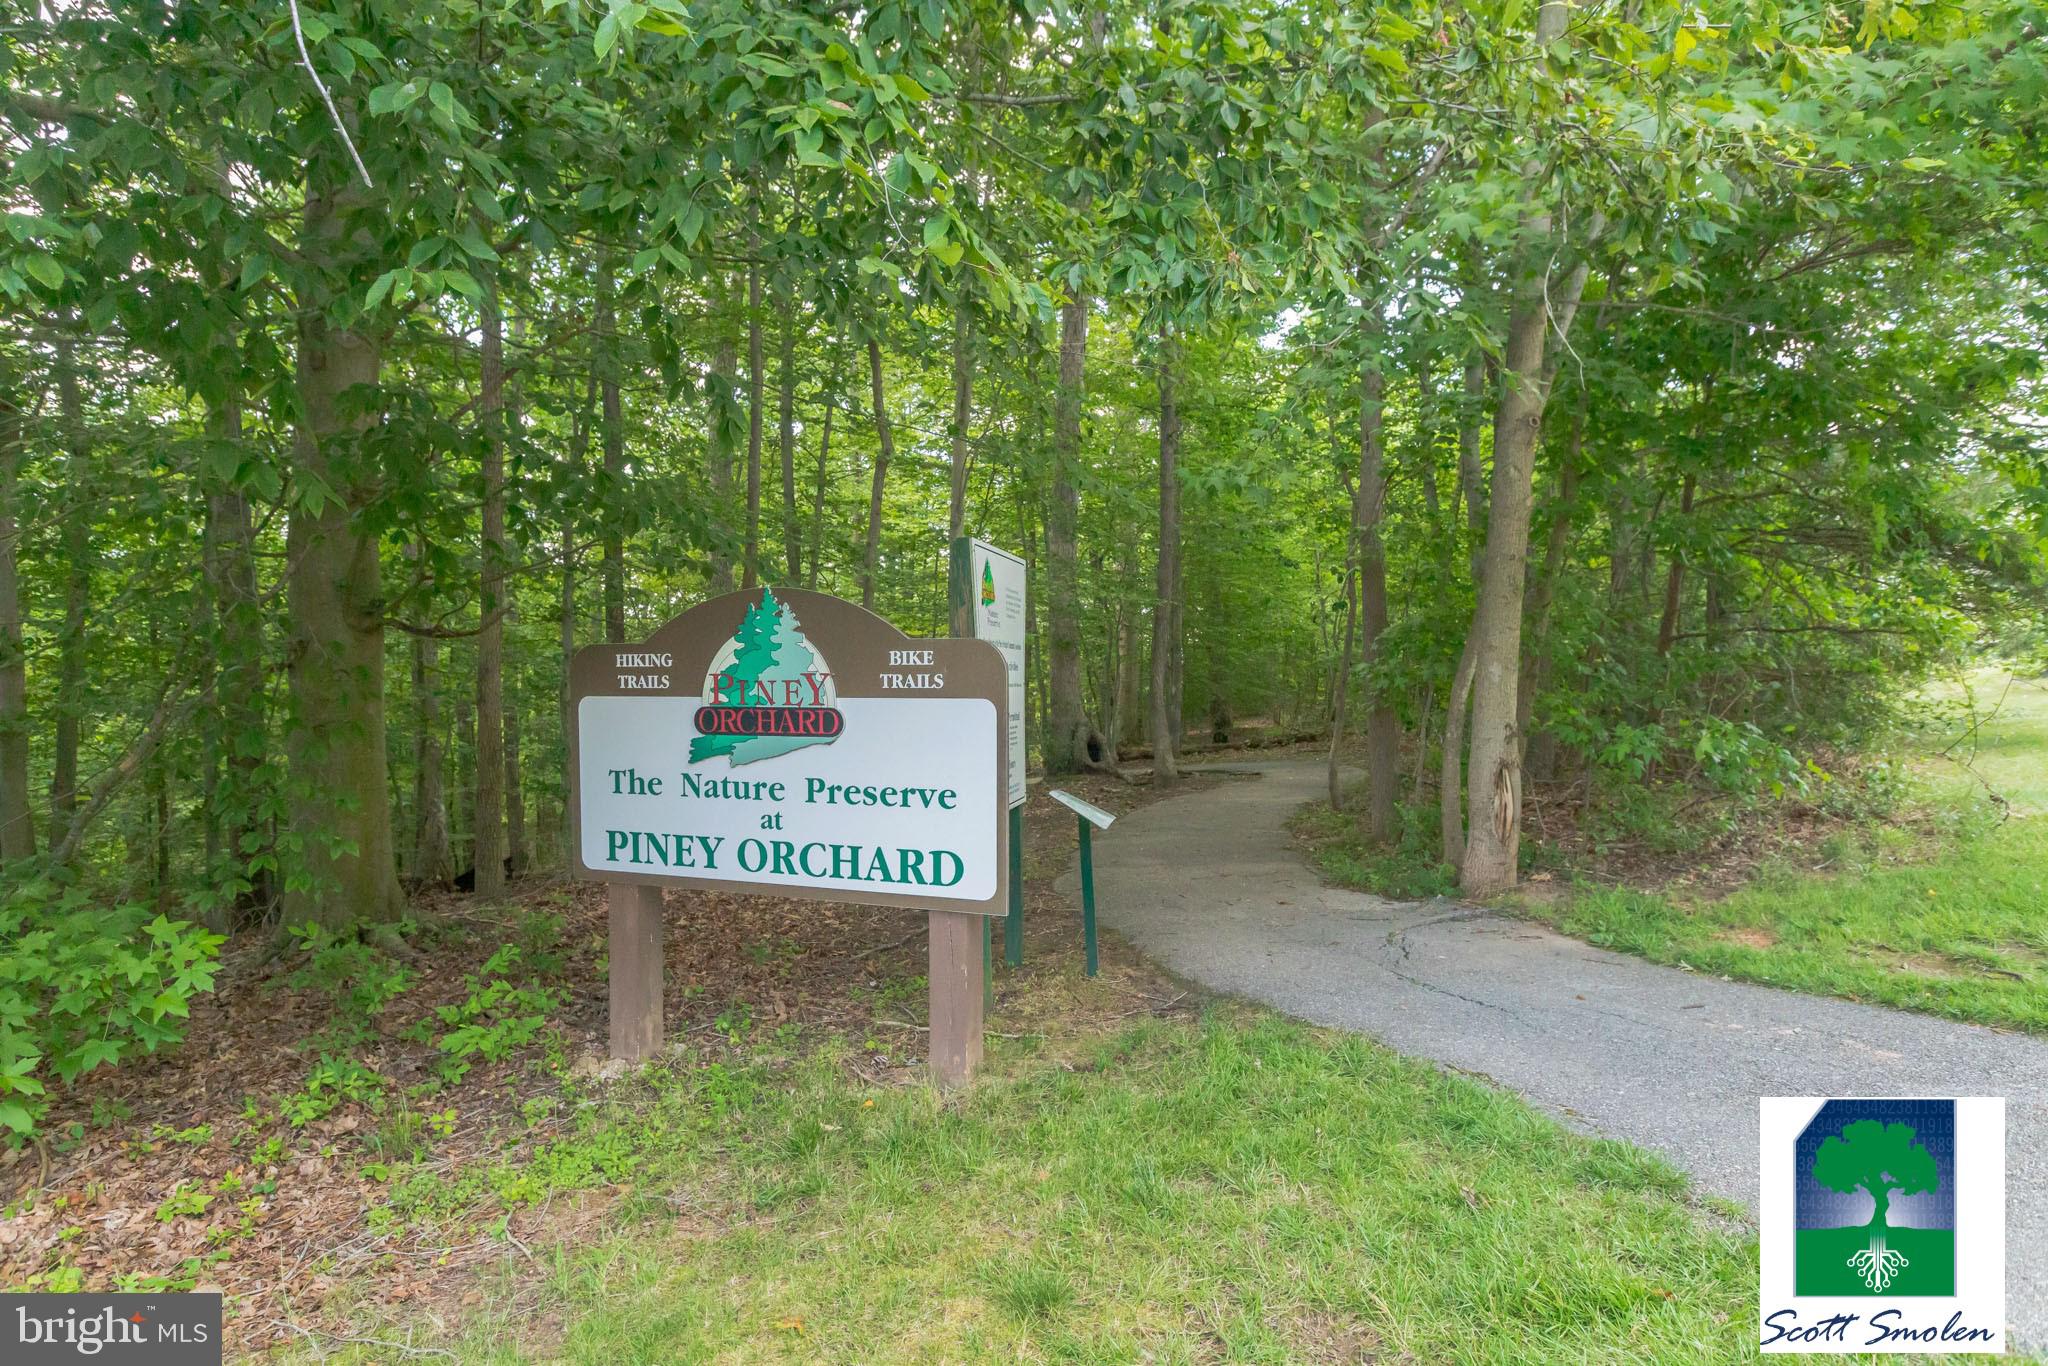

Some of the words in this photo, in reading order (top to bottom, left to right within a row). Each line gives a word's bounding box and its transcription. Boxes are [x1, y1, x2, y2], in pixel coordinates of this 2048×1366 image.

[616, 653, 673, 668] HIKING
[889, 650, 934, 666] BIKE
[617, 675, 670, 689] TRAILS
[709, 672, 831, 707] PINEY
[880, 673, 944, 689] TRAILS
[699, 709, 840, 735] ORCHARD
[608, 768, 663, 796] The
[681, 772, 785, 802] Nature
[805, 777, 957, 810] Preserve
[760, 811, 784, 831] at
[607, 830, 725, 870] PINEY
[737, 838, 965, 887] ORCHARD
